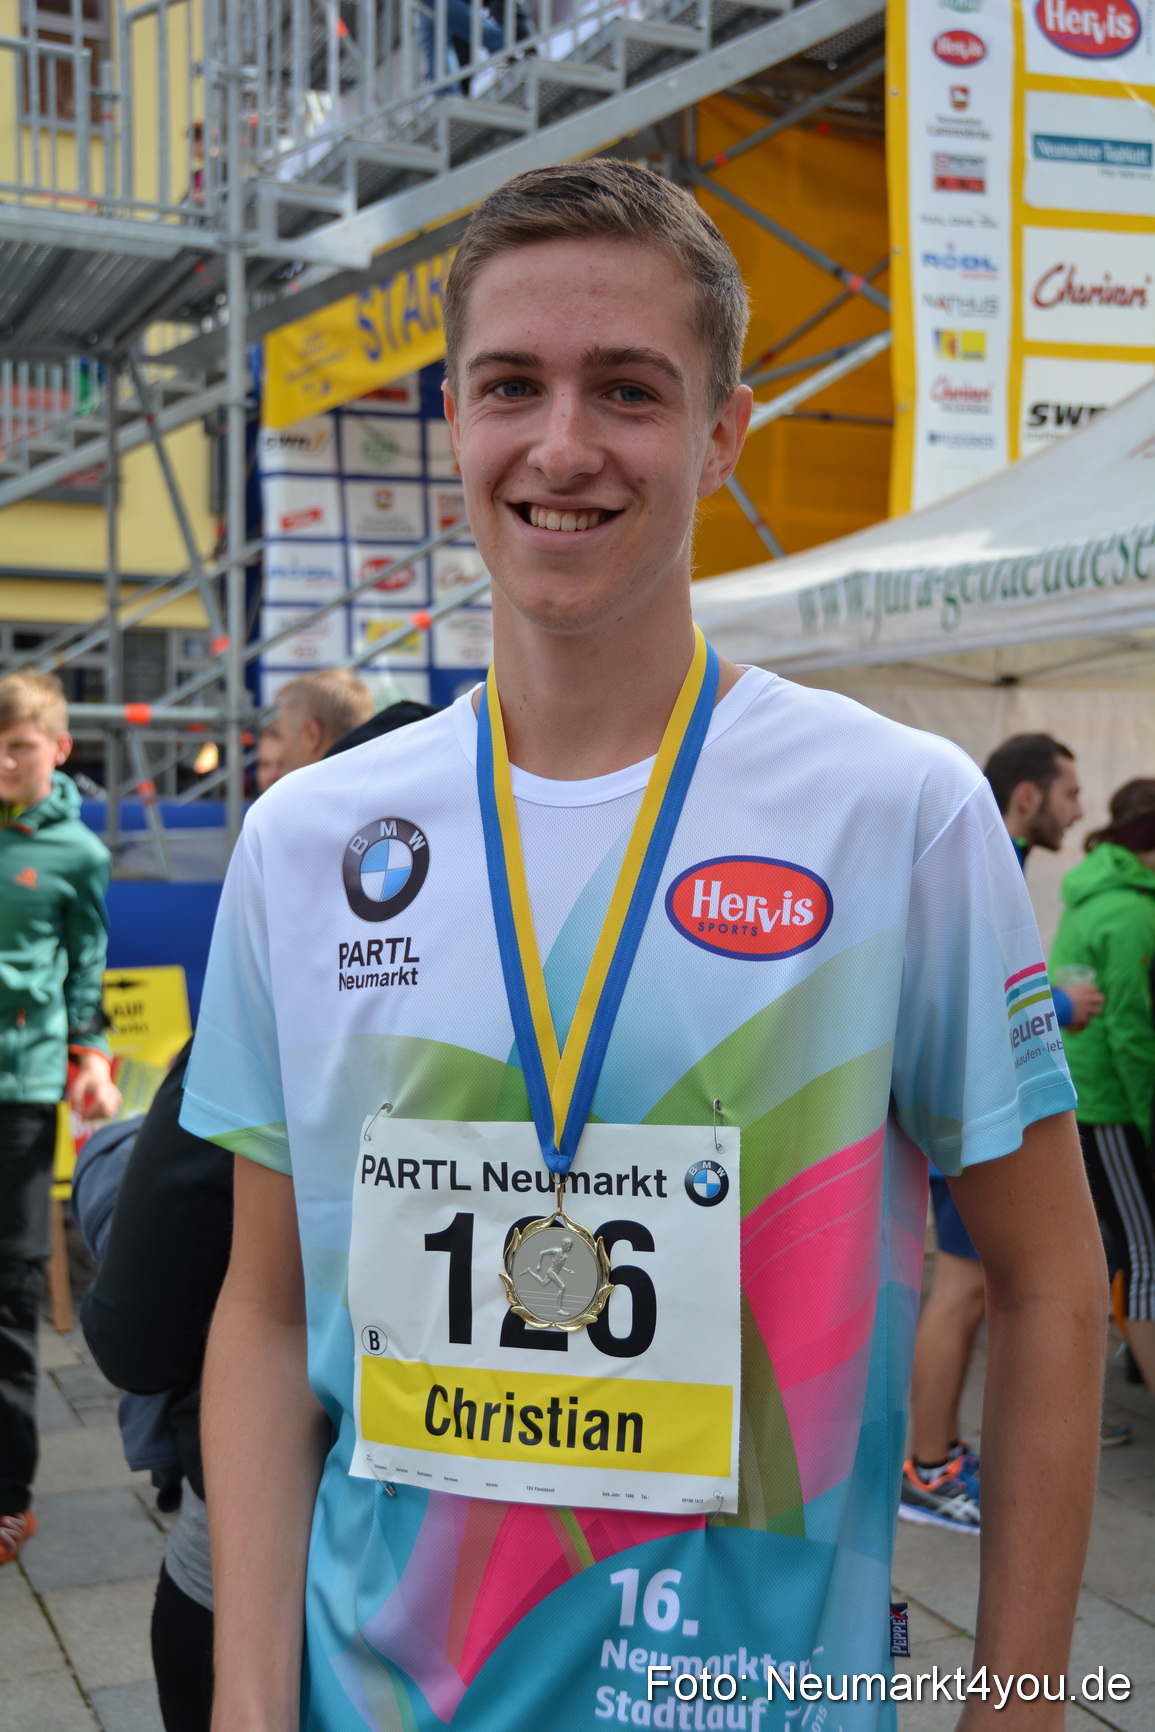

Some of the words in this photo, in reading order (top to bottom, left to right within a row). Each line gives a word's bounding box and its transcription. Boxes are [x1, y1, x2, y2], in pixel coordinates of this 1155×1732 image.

[1043, 0, 1134, 44] Hervis
[349, 820, 426, 856] BMW
[691, 879, 814, 933] Hervis
[697, 921, 759, 937] SPORTS
[338, 936, 420, 970] PARTL
[338, 966, 419, 992] Neumarkt
[1010, 1011, 1055, 1050] euer
[361, 1154, 472, 1191] PARTL
[482, 1161, 667, 1198] Neumarkt
[688, 1161, 726, 1178] BMW
[368, 1328, 381, 1352] B
[424, 1383, 643, 1454] Christian
[609, 1567, 699, 1636] 16.
[600, 1638, 811, 1686] Neumarkter
[594, 1685, 768, 1732] Stadtlauf
